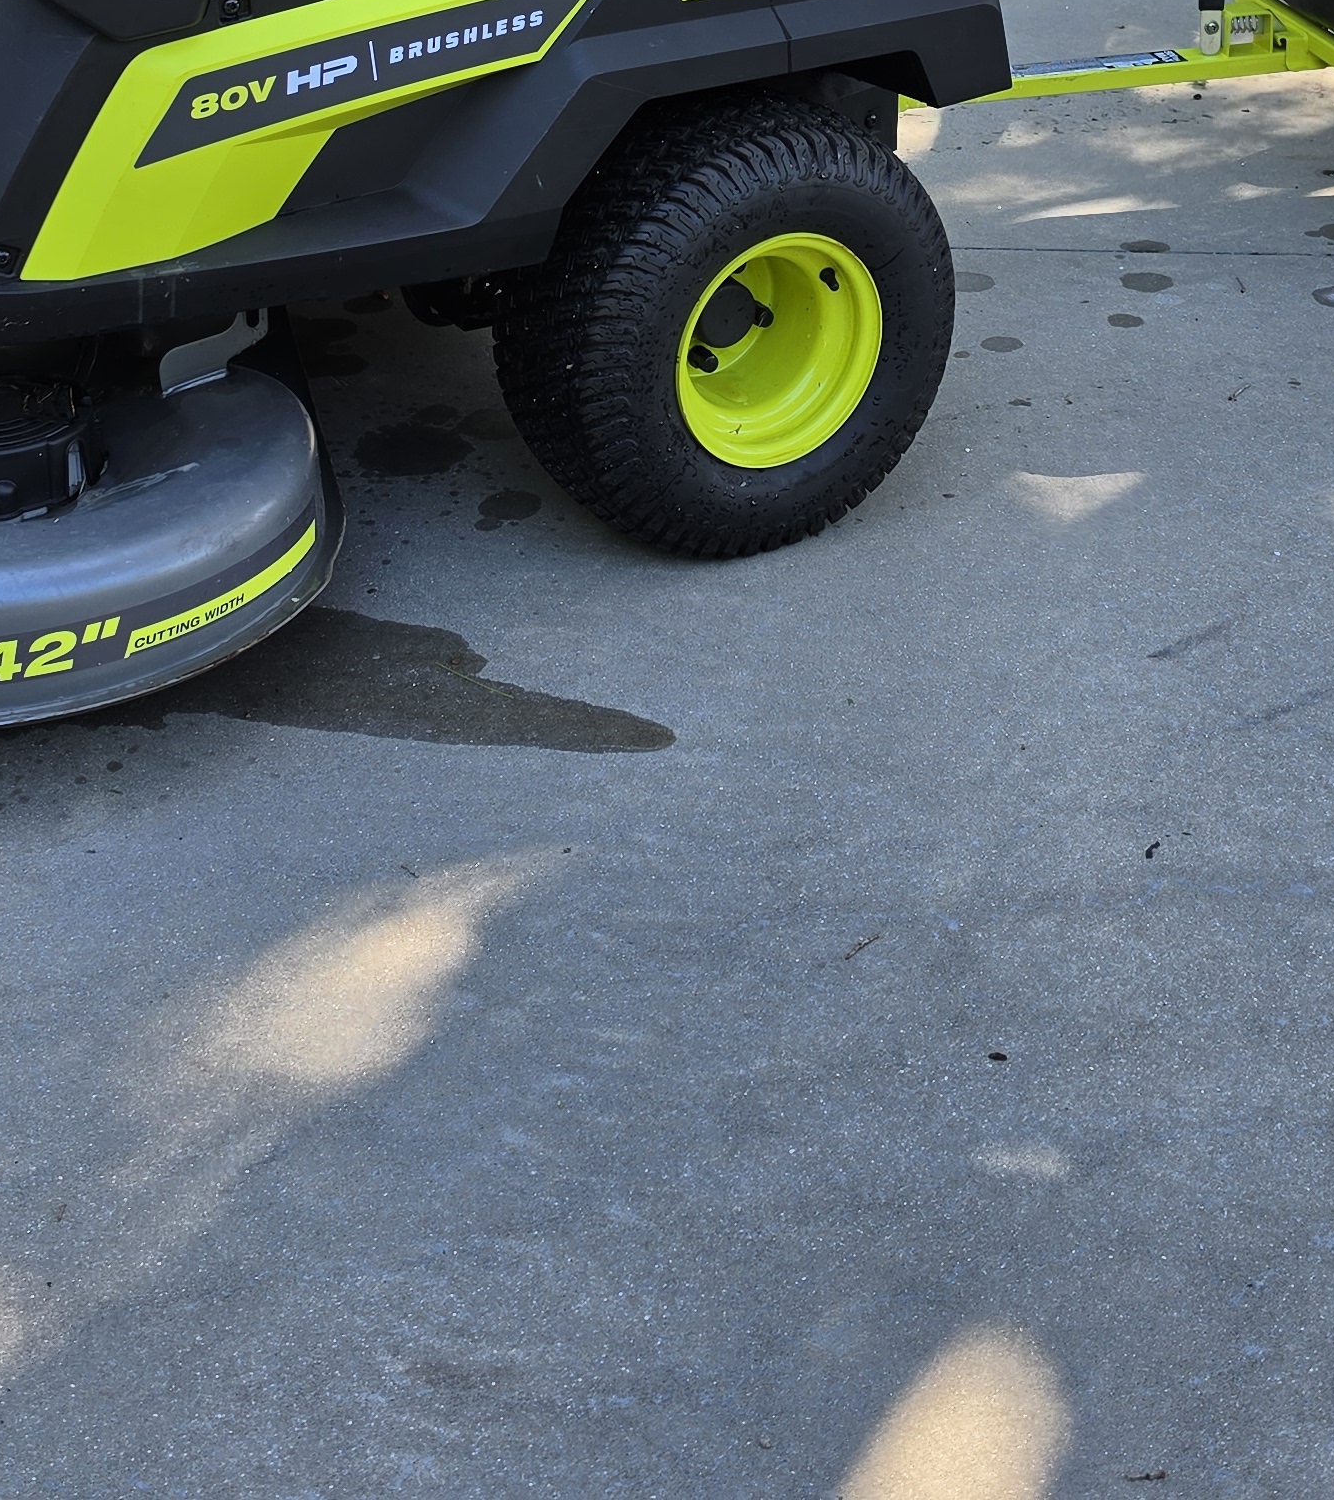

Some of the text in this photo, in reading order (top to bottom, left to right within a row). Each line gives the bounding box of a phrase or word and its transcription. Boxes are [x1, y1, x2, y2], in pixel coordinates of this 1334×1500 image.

[191, 10, 543, 119] 80V HP BRUSHLESS
[134, 615, 201, 649] CUTTING
[204, 593, 245, 621] WIDTH
